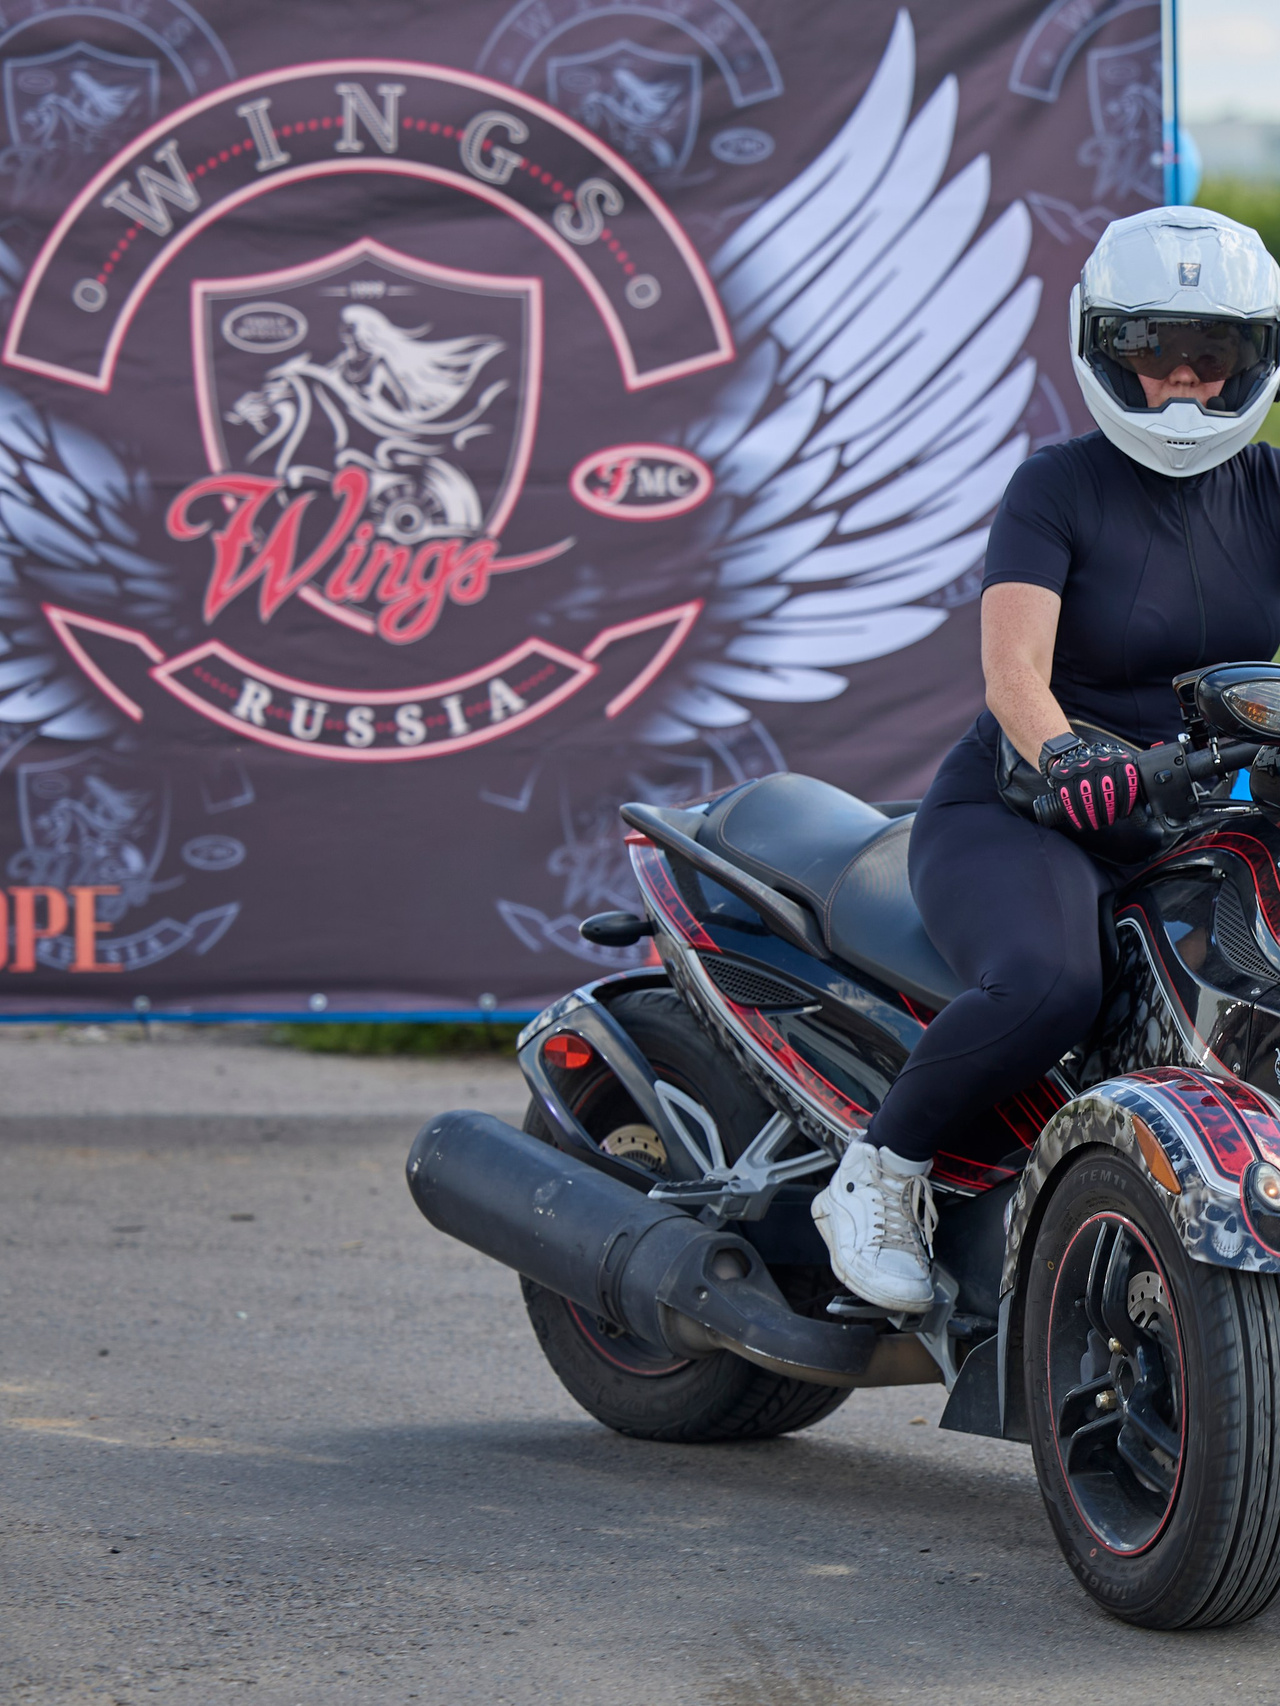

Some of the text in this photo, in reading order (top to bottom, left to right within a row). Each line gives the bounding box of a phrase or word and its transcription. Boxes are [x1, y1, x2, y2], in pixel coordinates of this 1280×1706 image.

[103, 83, 625, 246] WINGS
[166, 465, 575, 645] Wings
[232, 678, 527, 748] RUSSIA
[0, 885, 124, 973] PE
